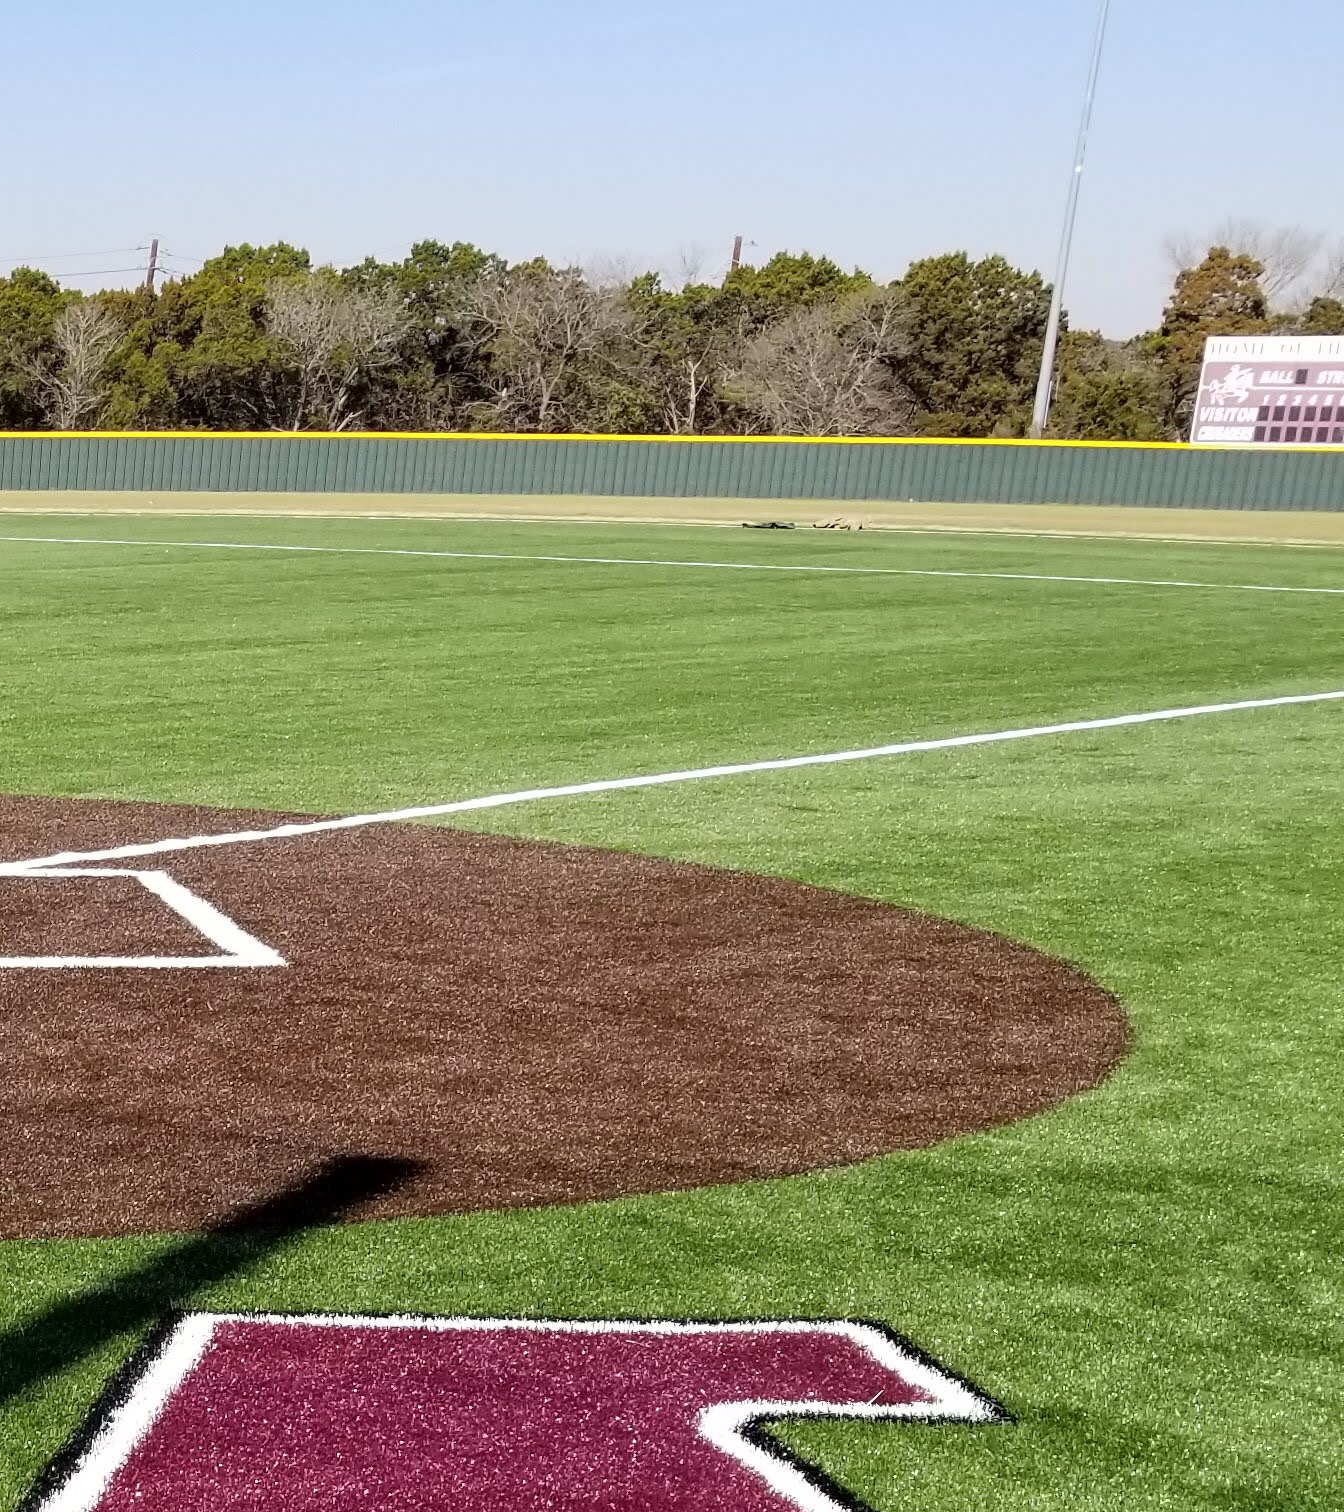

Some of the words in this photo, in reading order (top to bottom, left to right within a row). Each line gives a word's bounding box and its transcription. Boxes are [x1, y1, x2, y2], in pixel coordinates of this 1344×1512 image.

[1210, 342, 1265, 355] HOME
[1280, 341, 1303, 355] OF
[1259, 370, 1294, 384] BALL
[1263, 394, 1270, 405] 1
[1276, 394, 1287, 405] 2
[1292, 394, 1303, 405] 3
[1308, 394, 1318, 405] 4
[1324, 394, 1334, 405] 5
[1199, 407, 1259, 422] VISITOR
